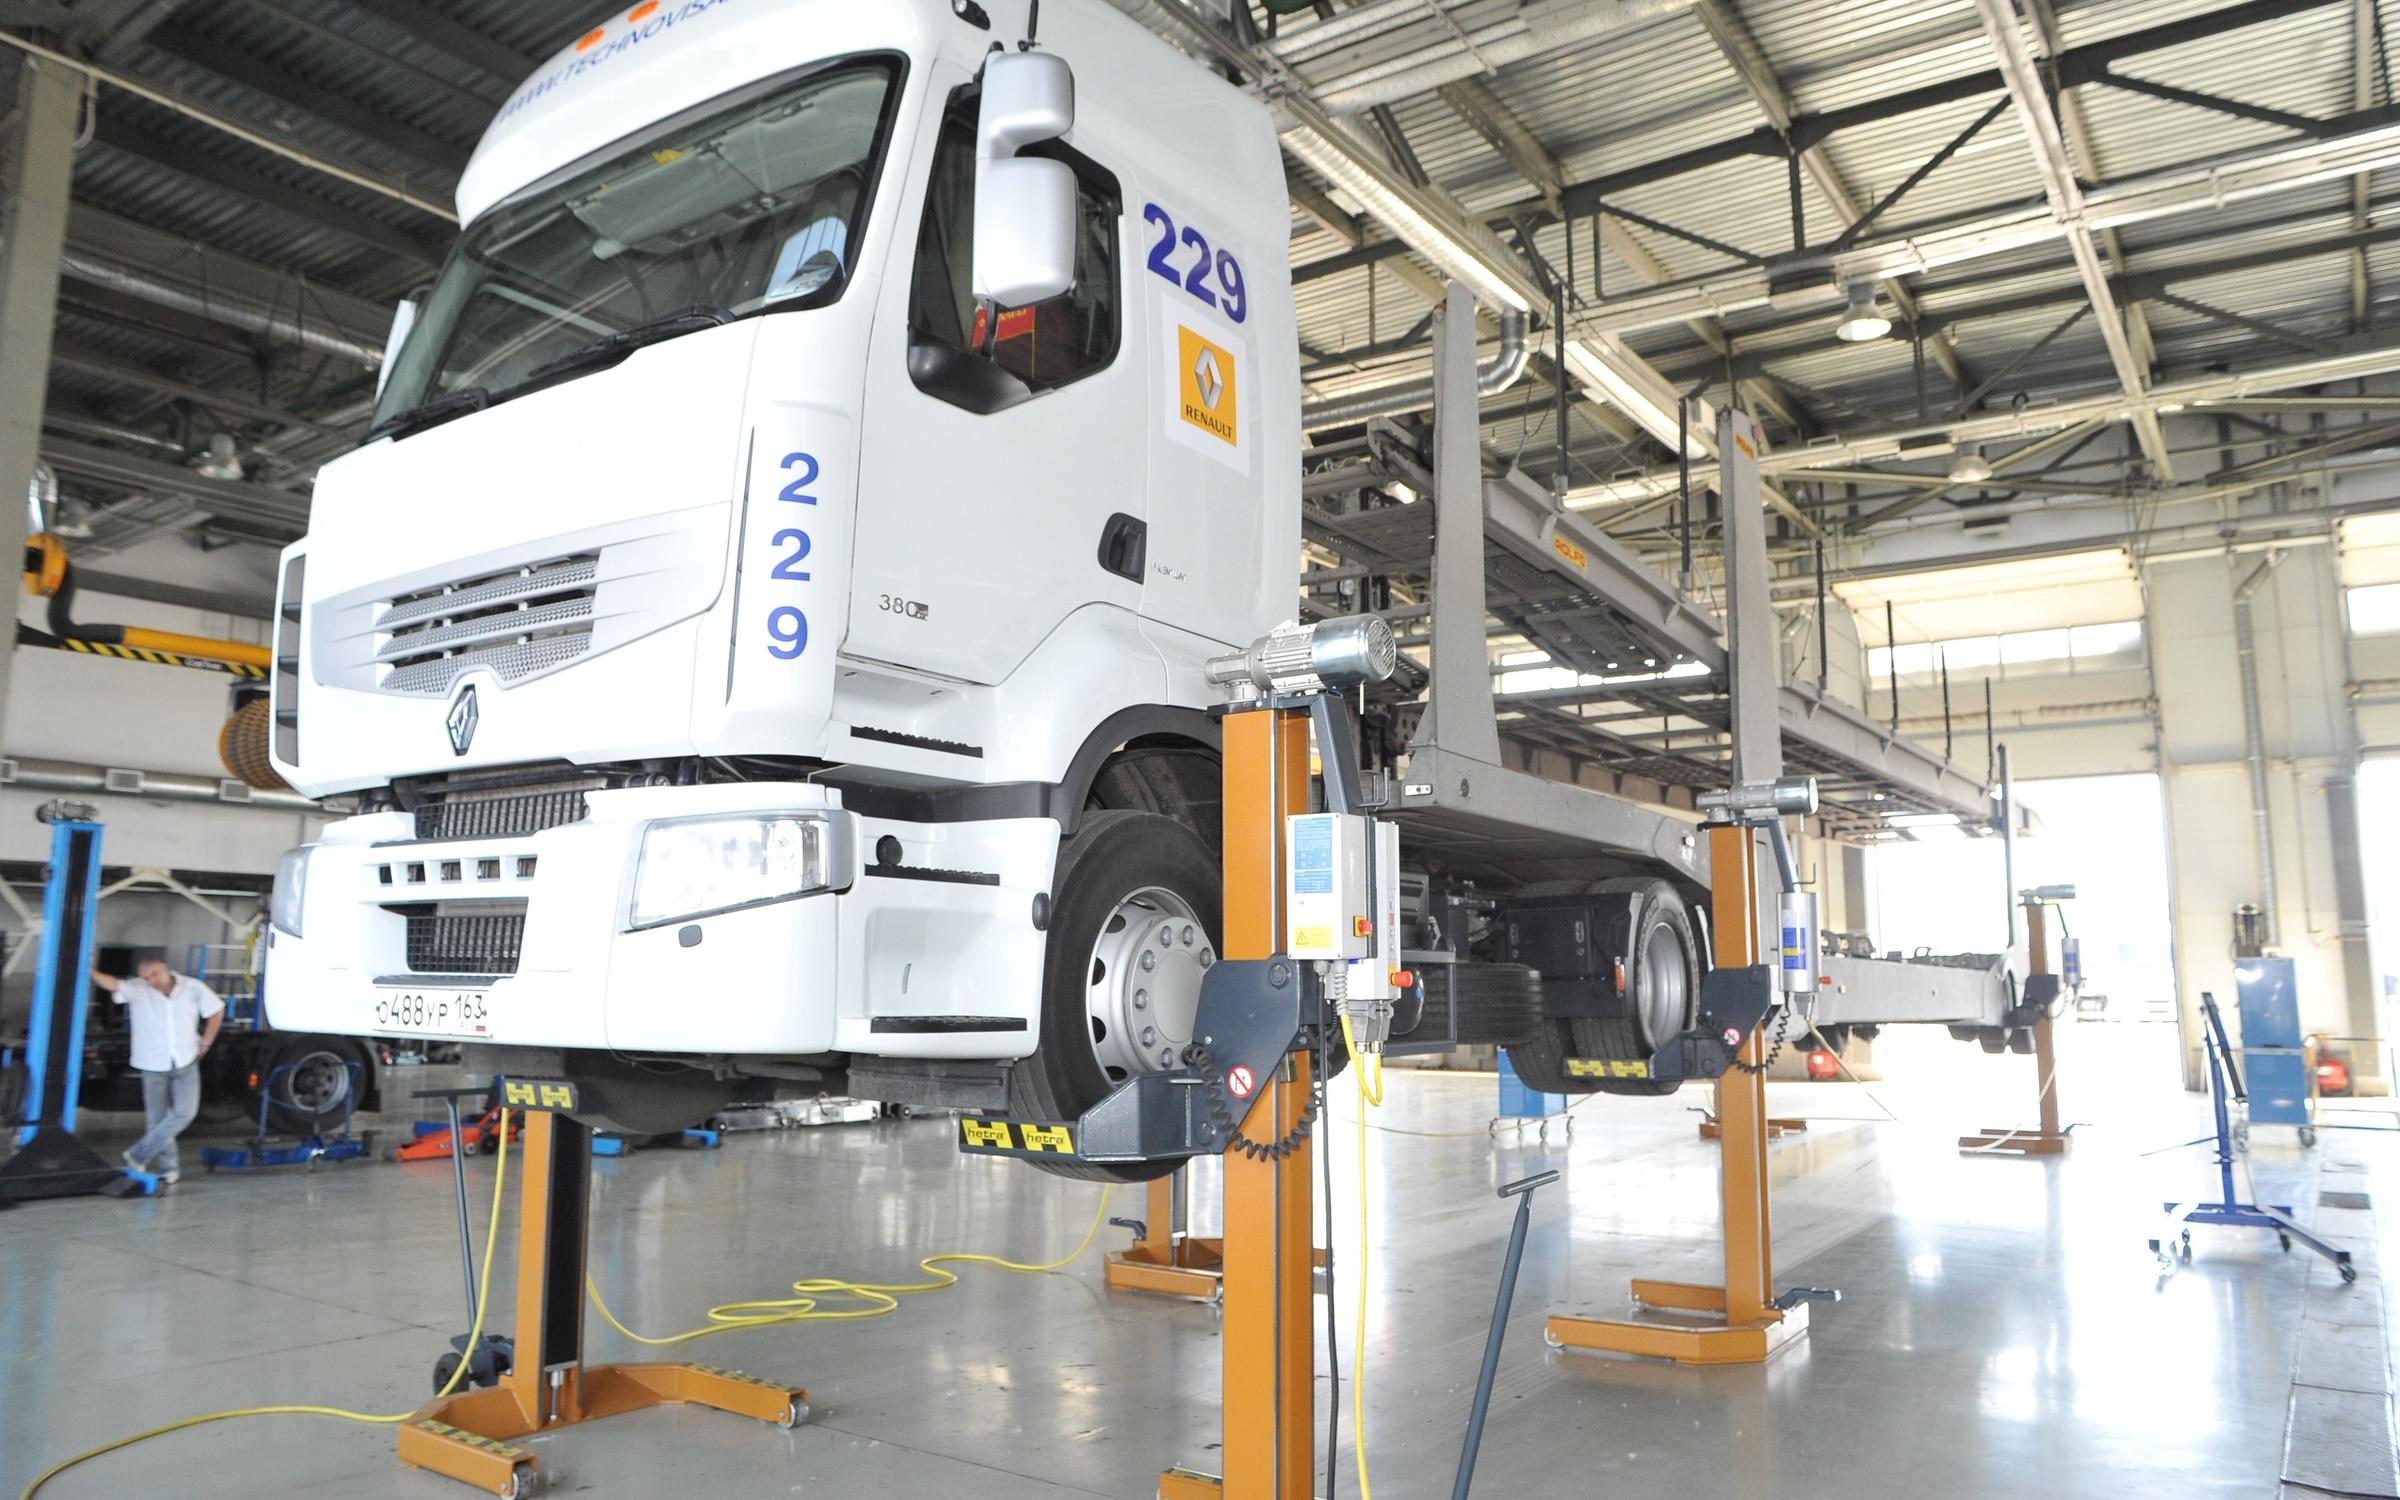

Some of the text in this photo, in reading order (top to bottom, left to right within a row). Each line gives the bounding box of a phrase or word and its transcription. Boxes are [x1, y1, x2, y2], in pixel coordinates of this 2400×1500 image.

[1143, 202, 1247, 324] 229
[1185, 404, 1233, 439] RENAULT
[454, 993, 483, 1020] 163
[967, 1128, 1005, 1140] hetra
[1026, 1133, 1064, 1145] hetra
